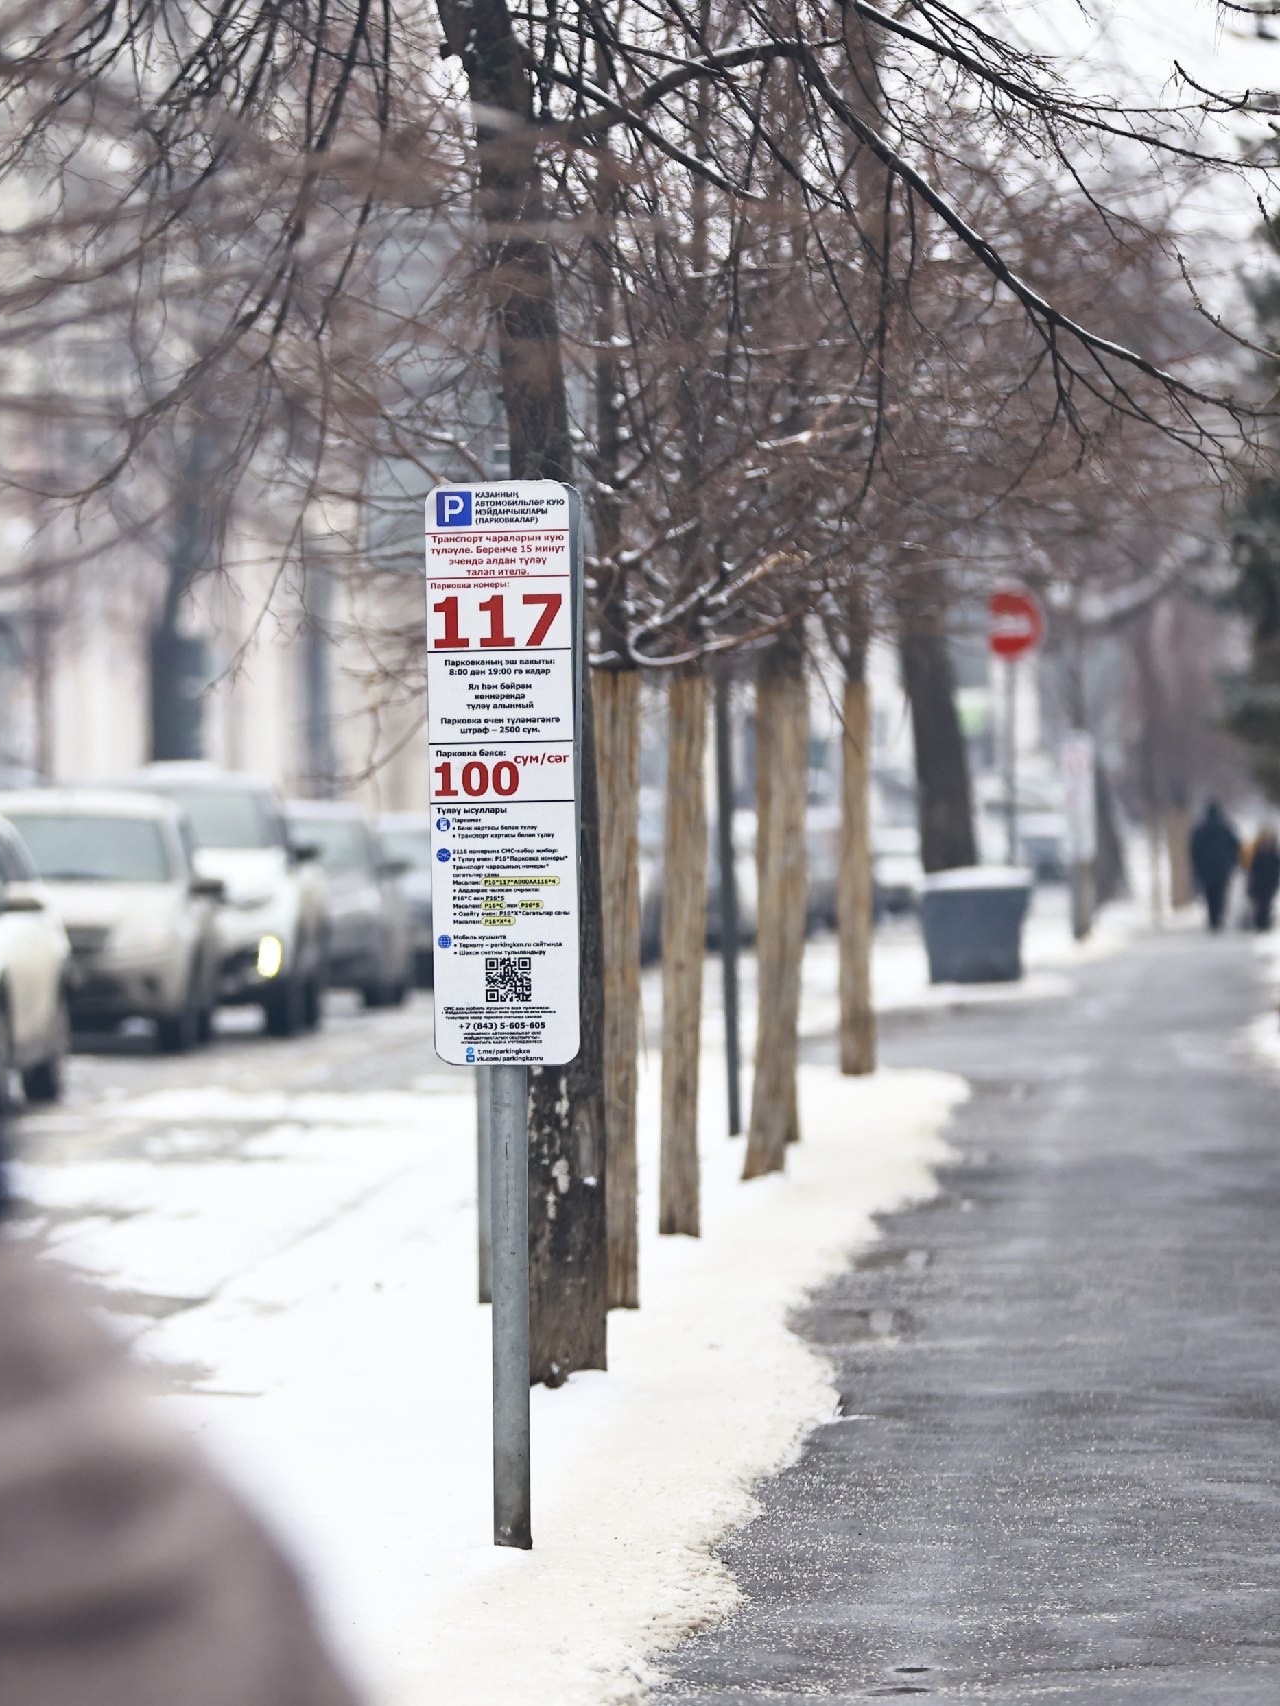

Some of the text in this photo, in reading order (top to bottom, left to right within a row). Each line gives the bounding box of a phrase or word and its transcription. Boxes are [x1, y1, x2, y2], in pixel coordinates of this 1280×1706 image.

[444, 495, 464, 522] P
[475, 508, 548, 516] МӘЙДАНЧЫКЛАРЫ
[475, 516, 538, 524] (ПАРКОВКАЛАР)
[431, 535, 564, 544] Транспорт чараларын кую
[476, 546, 518, 555] Беренче
[535, 545, 565, 554] минут
[449, 557, 483, 566] эчендә
[519, 557, 547, 566] түләү
[434, 594, 562, 648] 117
[445, 659, 503, 667] Парковканың
[460, 727, 489, 735] штраф
[434, 761, 519, 797] 100
[436, 807, 507, 816] Түләү ысуллары
[473, 1022, 497, 1031] (843)
